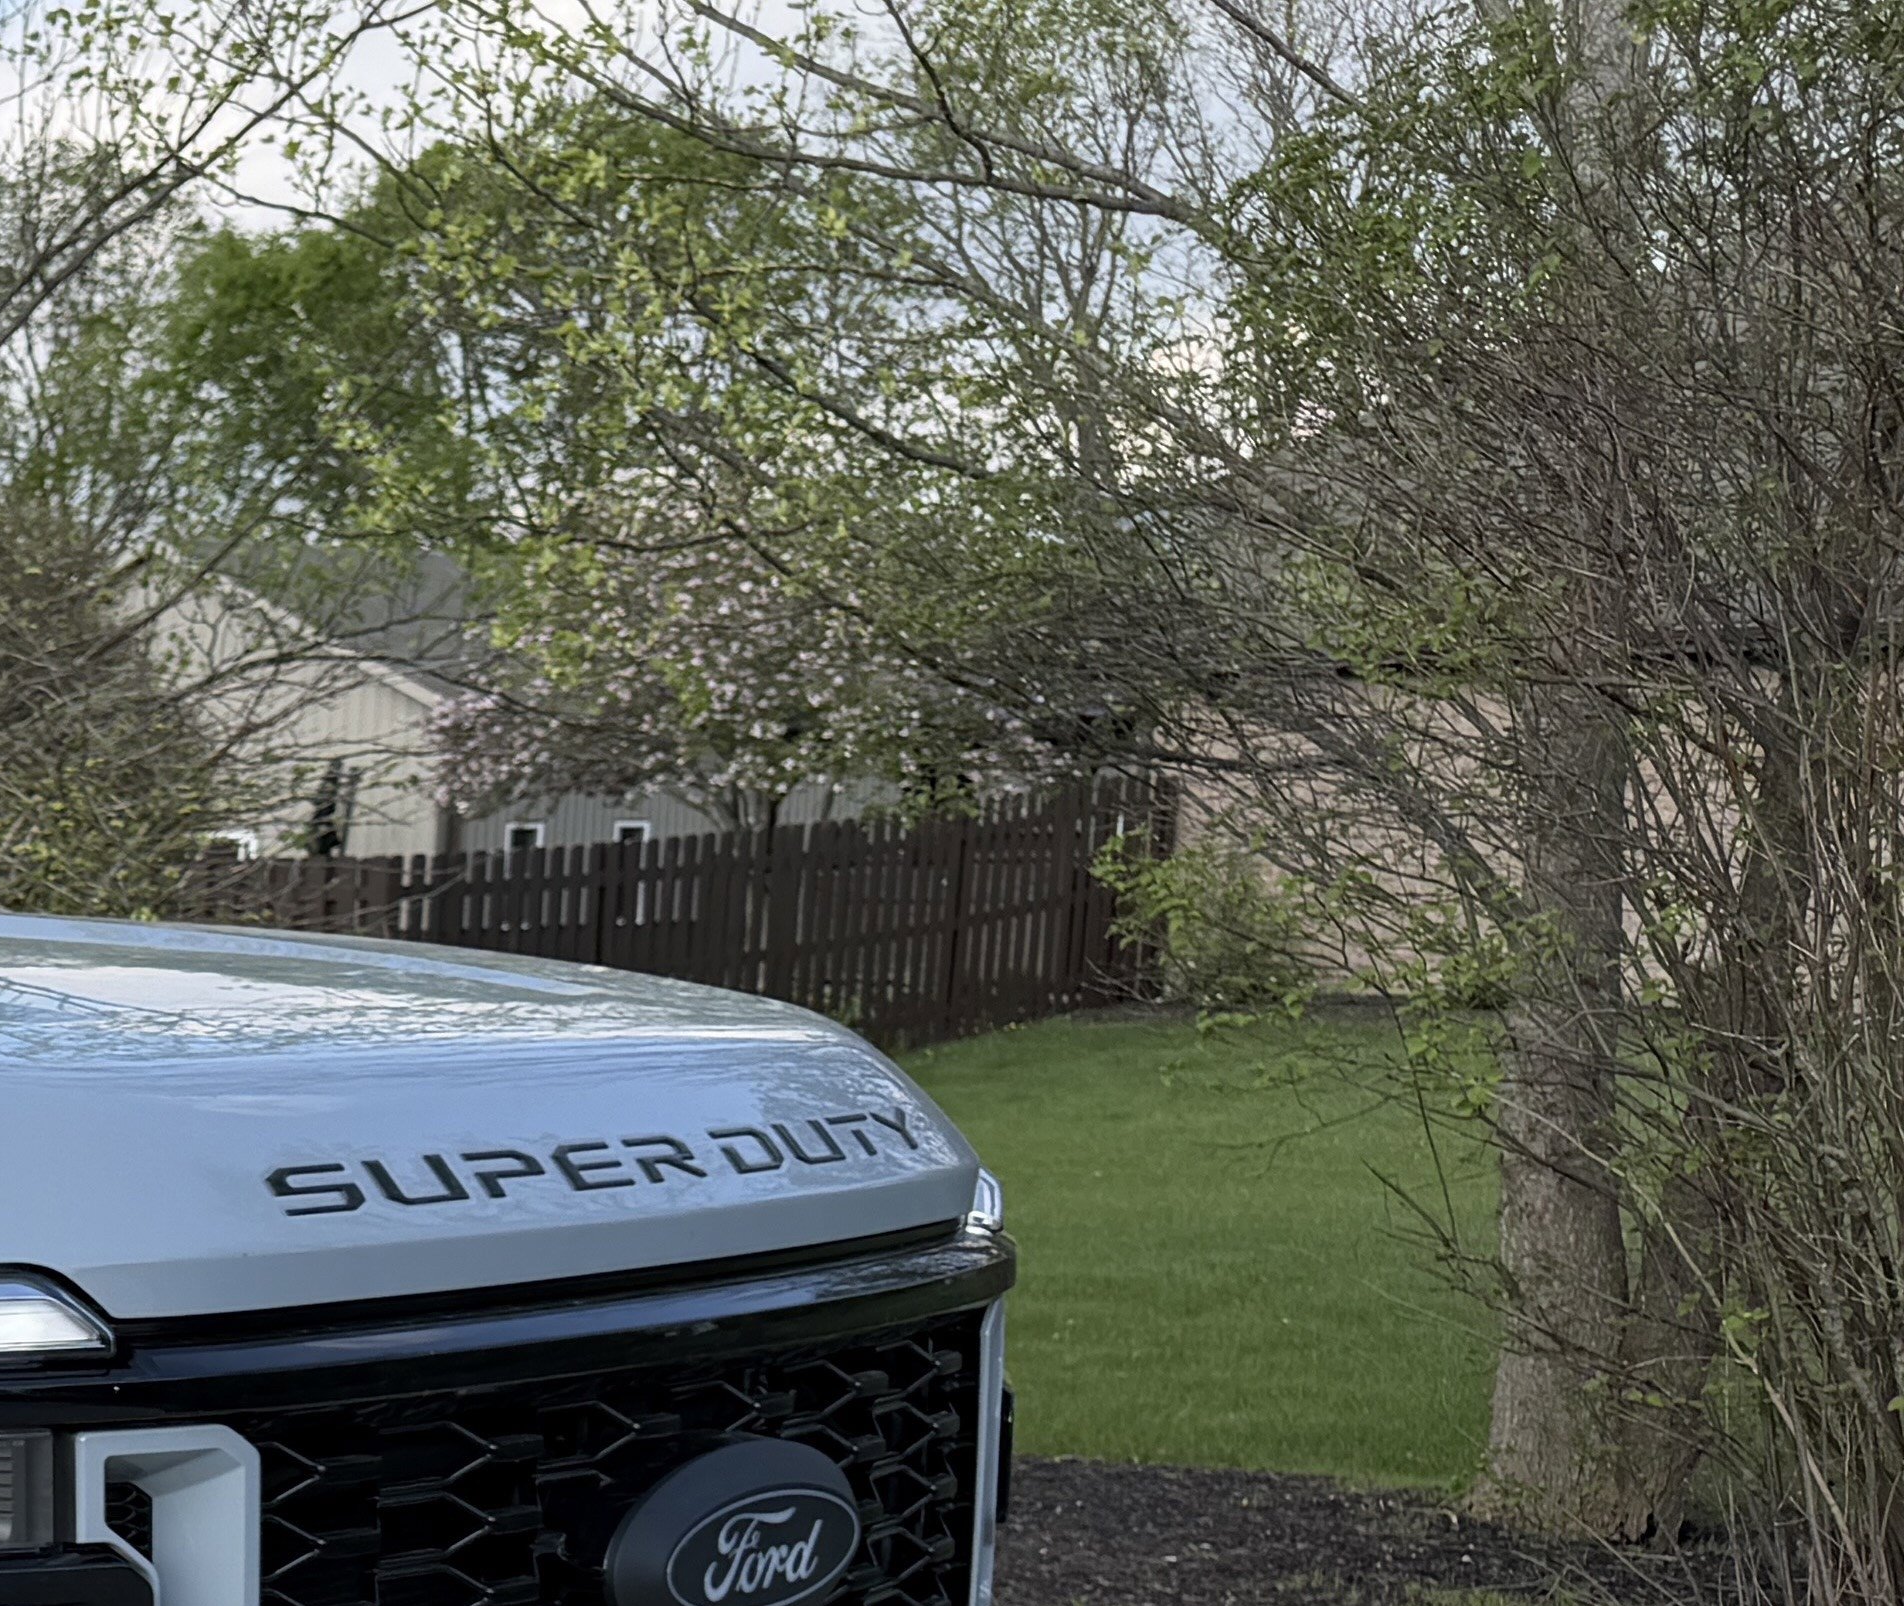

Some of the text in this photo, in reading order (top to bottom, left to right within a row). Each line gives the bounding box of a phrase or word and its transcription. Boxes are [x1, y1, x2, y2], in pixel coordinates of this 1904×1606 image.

[264, 1107, 919, 1217] SUPER DUTY
[703, 1506, 824, 1602] Ford
